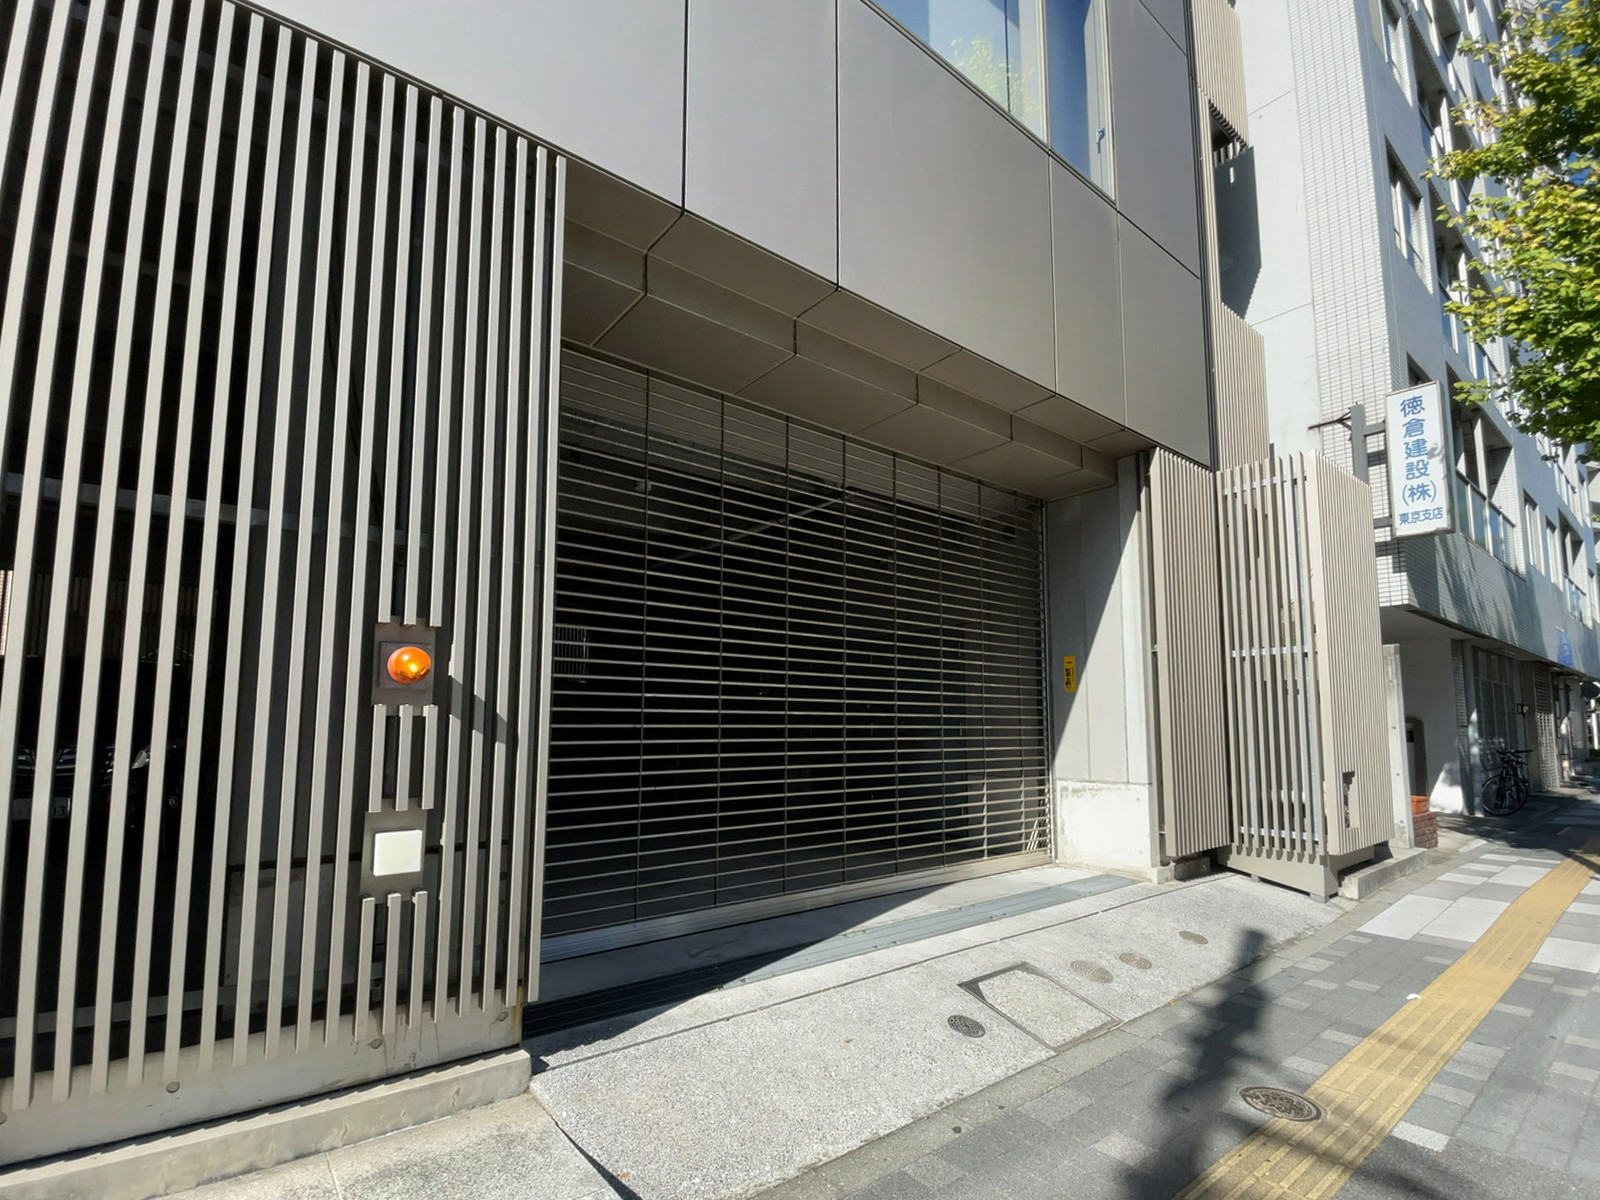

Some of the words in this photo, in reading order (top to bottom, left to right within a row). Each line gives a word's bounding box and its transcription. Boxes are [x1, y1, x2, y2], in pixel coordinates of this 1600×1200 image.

[1400, 395, 1436, 506] 徳倉建設(株)
[1398, 507, 1444, 526] 東京支店
